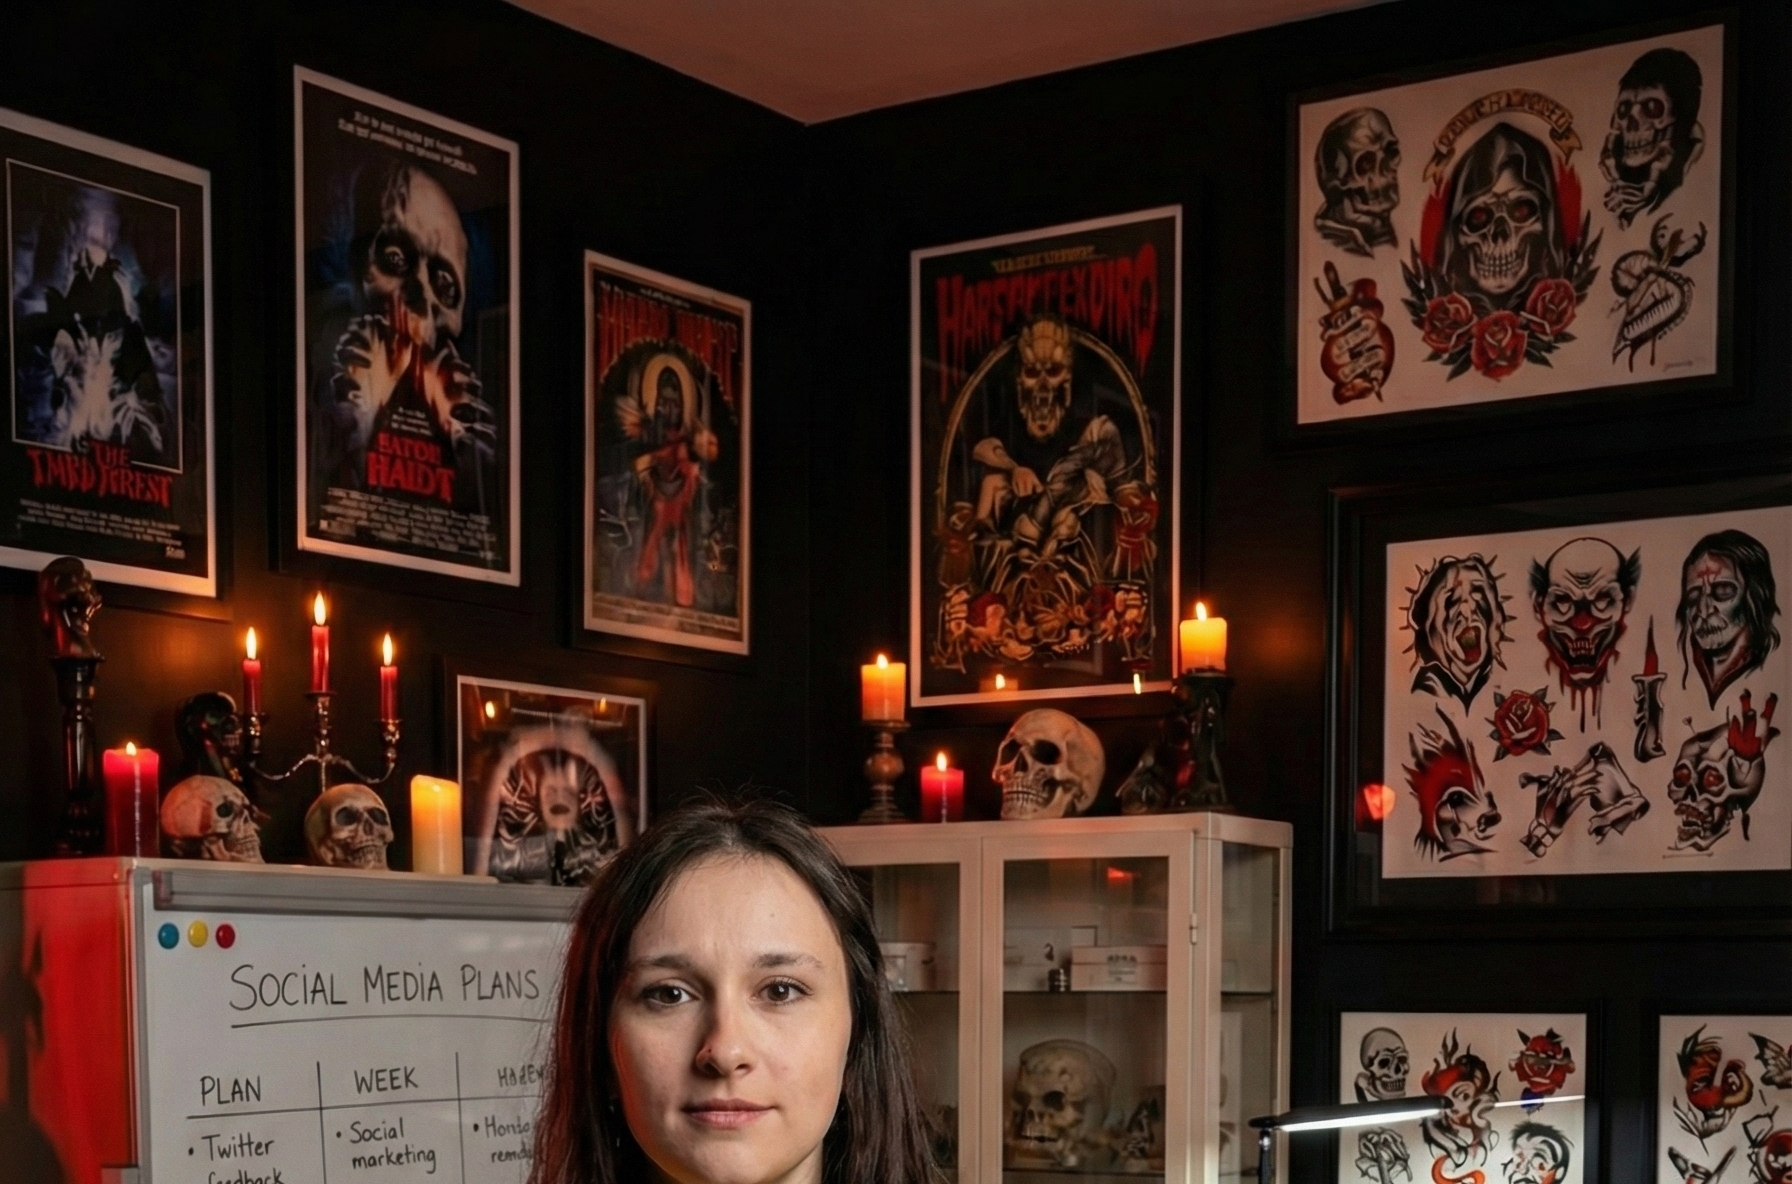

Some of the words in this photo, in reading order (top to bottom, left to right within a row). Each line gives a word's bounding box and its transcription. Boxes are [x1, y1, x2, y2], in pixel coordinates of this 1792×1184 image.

[229, 963, 347, 1011] SOCIAL
[363, 961, 443, 1004] MEDIA
[461, 963, 540, 1001] PLANS
[200, 1075, 262, 1107] PLAN
[354, 1066, 419, 1094] WEEK
[350, 1117, 405, 1144] Social
[201, 1132, 275, 1161] Twitter
[352, 1144, 437, 1174] marketing
